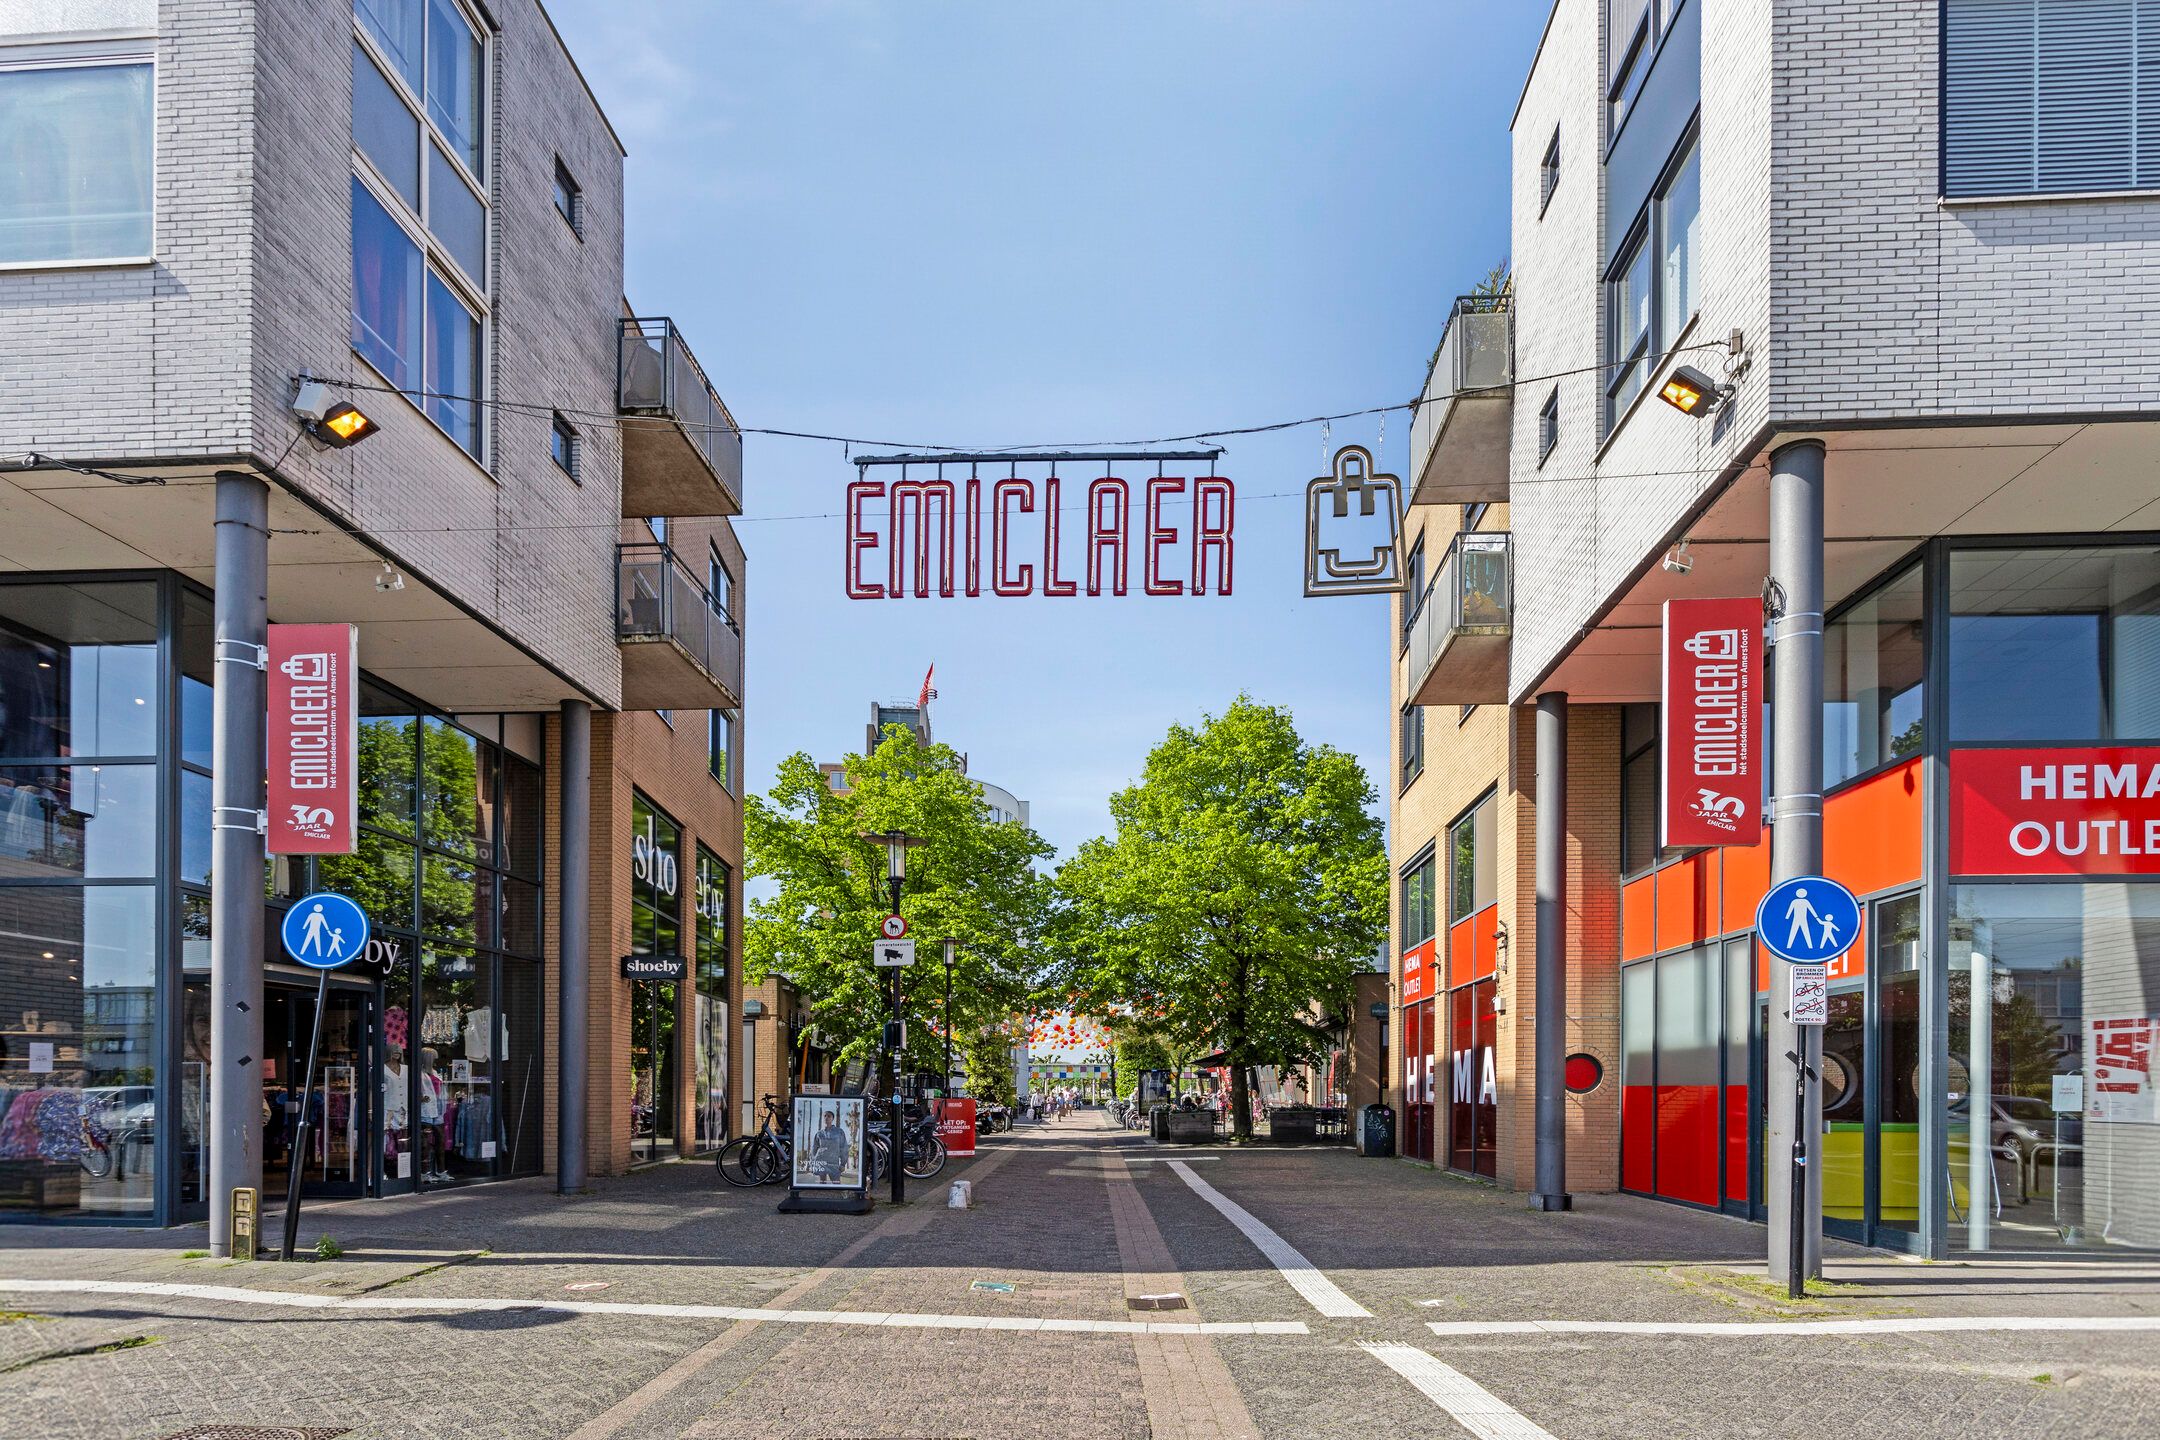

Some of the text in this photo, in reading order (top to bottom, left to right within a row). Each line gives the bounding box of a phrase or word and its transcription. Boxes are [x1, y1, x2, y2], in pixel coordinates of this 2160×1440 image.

[847, 477, 1235, 599] EMICLAER
[1740, 629, 1748, 673] Amersfoort
[329, 653, 337, 694] Amersfoort
[290, 685, 328, 789] EMICLAER
[1694, 664, 1738, 776] EMICLAER
[1740, 690, 1748, 760] stadsdeelcentrum
[329, 709, 337, 774] stadsdeelcentrum
[286, 804, 334, 832] 30
[1690, 788, 1745, 822] 30
[1707, 819, 1736, 831] EMICLAER
[293, 823, 321, 831] JAAR
[304, 831, 331, 840] EMICLAER
[626, 959, 682, 975] shoeby
[1405, 953, 1420, 973] HEMA
[1407, 1046, 1498, 1105] HEMA
